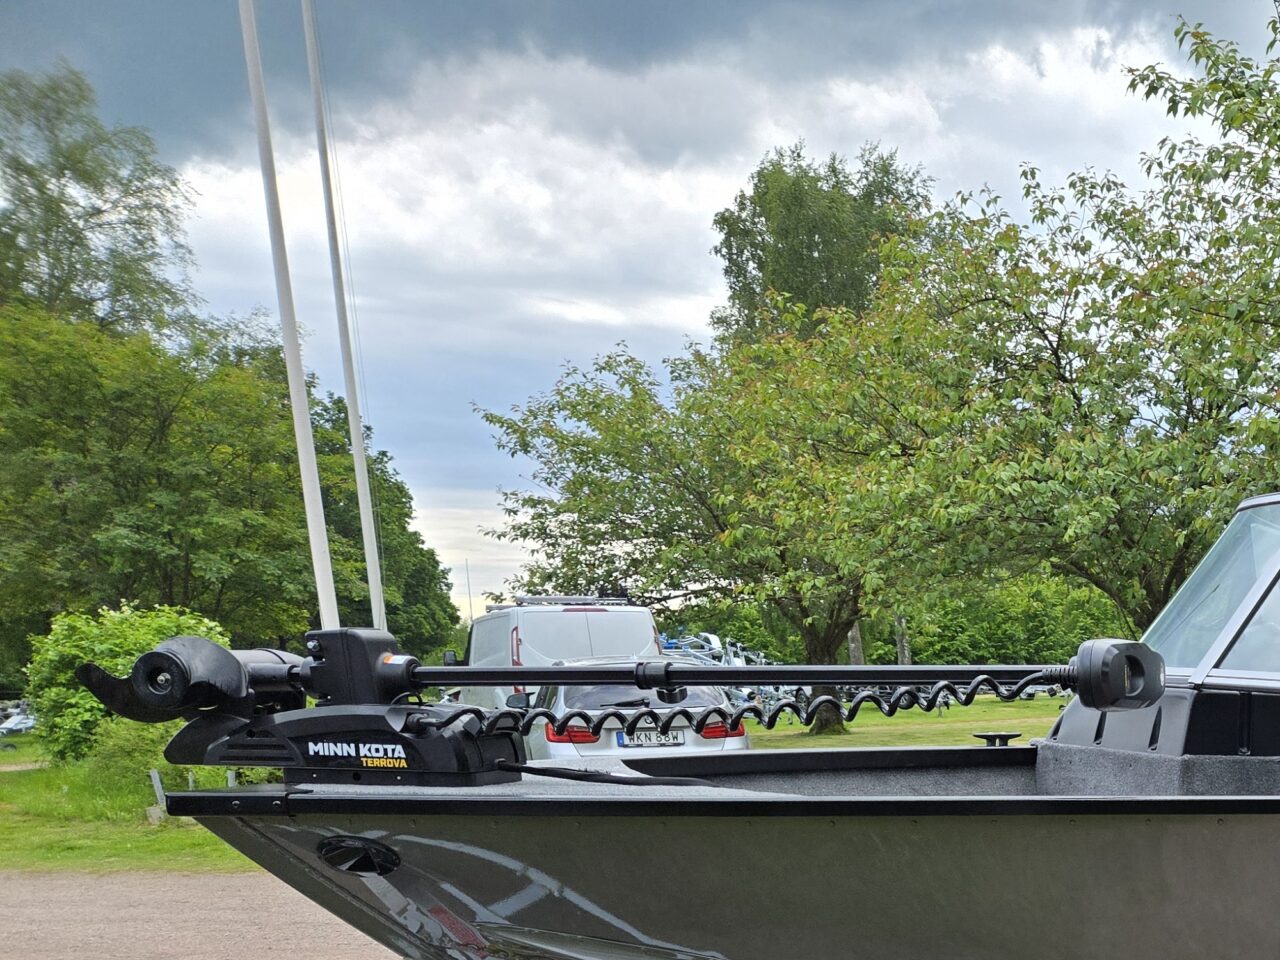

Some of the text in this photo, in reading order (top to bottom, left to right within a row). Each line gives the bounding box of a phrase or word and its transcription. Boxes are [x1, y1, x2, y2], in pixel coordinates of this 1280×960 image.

[308, 741, 407, 758] MINN KOTA
[360, 757, 408, 768] TERROVA
